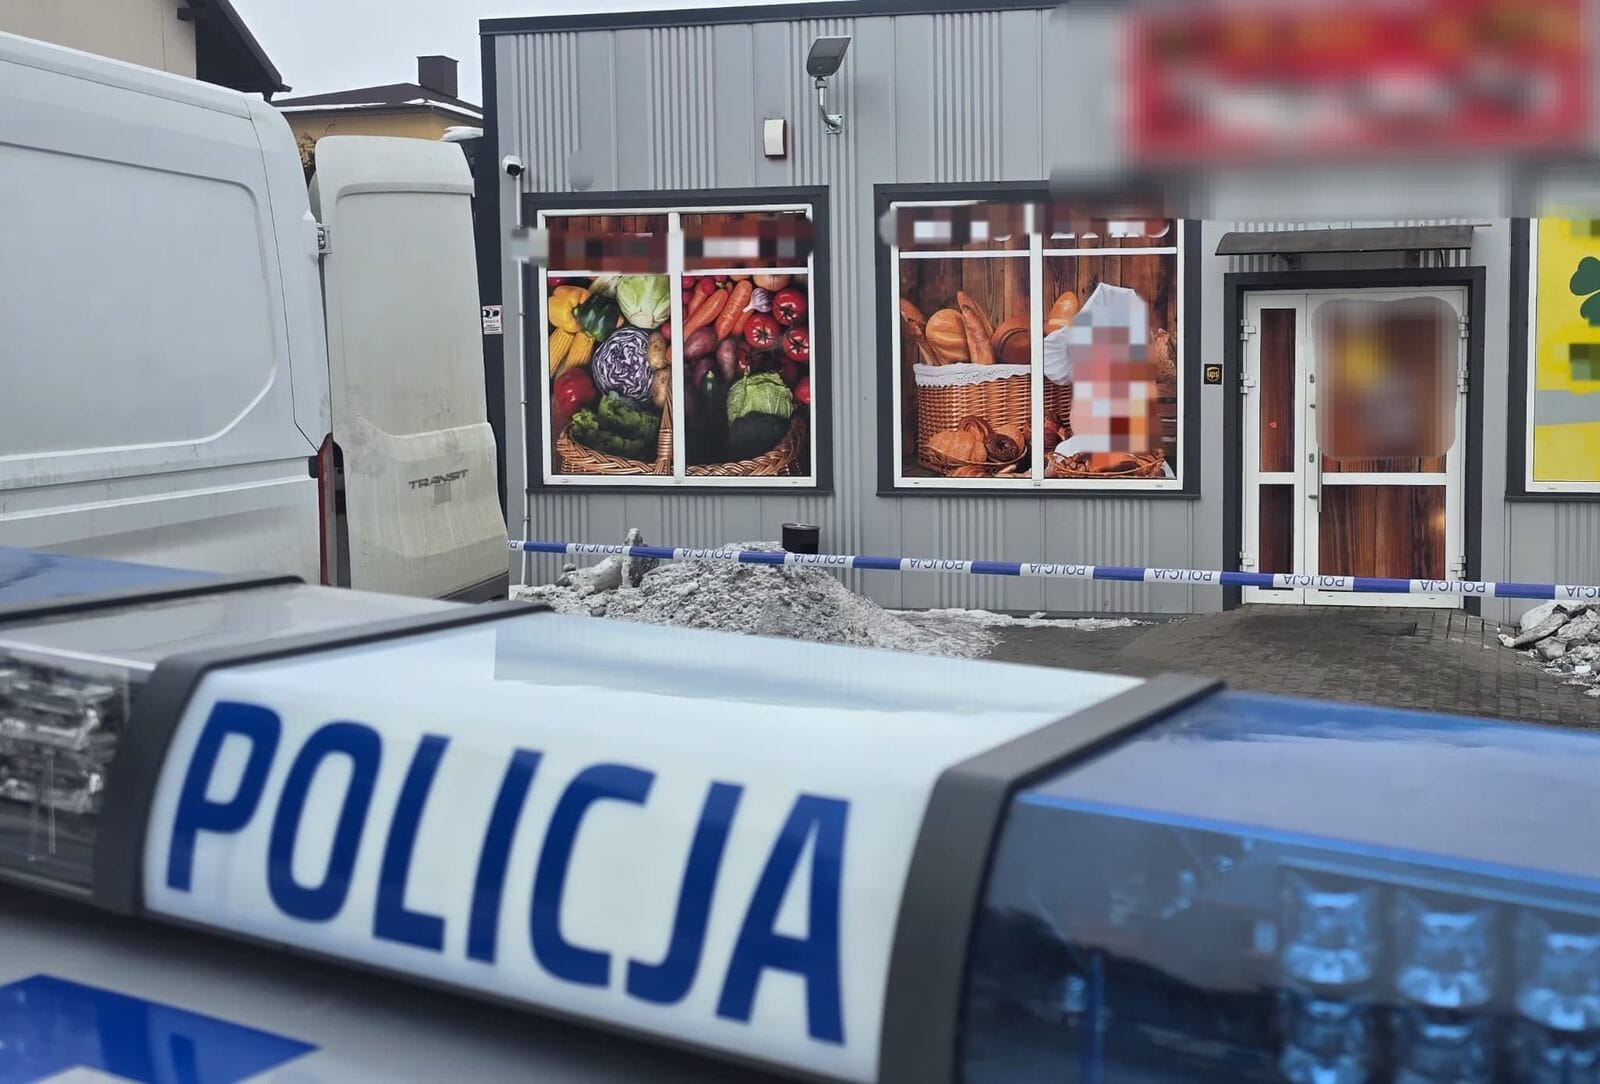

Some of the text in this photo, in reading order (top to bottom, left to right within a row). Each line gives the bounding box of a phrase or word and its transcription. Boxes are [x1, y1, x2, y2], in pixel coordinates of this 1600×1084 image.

[408, 469, 469, 489] TRANSIT
[683, 549, 732, 559] POLICJA
[794, 554, 846, 564] POLICJA
[910, 559, 964, 570] POLICJA
[1030, 563, 1086, 575] POLICJA
[1154, 569, 1212, 581] POLICJA
[1283, 575, 1345, 587] POLICJA
[1420, 580, 1486, 593] POLICJA
[1565, 586, 1600, 598] ICJA
[166, 701, 850, 1046] POLICJA
